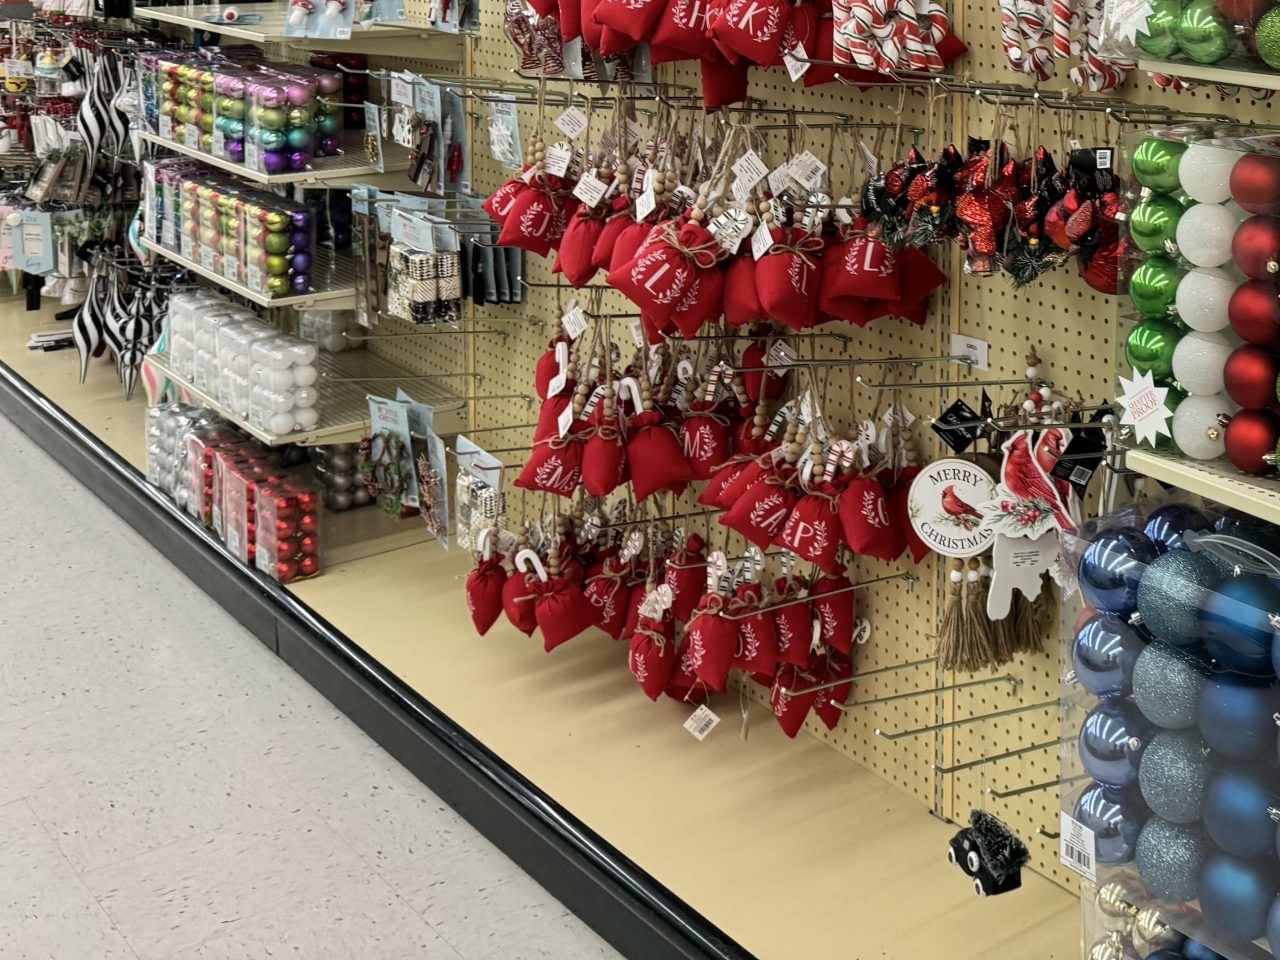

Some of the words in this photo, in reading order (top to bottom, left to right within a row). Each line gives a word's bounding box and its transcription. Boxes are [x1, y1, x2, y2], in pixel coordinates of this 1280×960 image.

[738, 1, 766, 36] K
[532, 211, 552, 237] J
[863, 242, 879, 272] L
[644, 263, 671, 296] L
[684, 430, 700, 458] M
[929, 468, 984, 487] MERRY
[760, 507, 787, 532] A
[793, 521, 814, 548] P
[920, 521, 993, 549] CHRISTMAS
